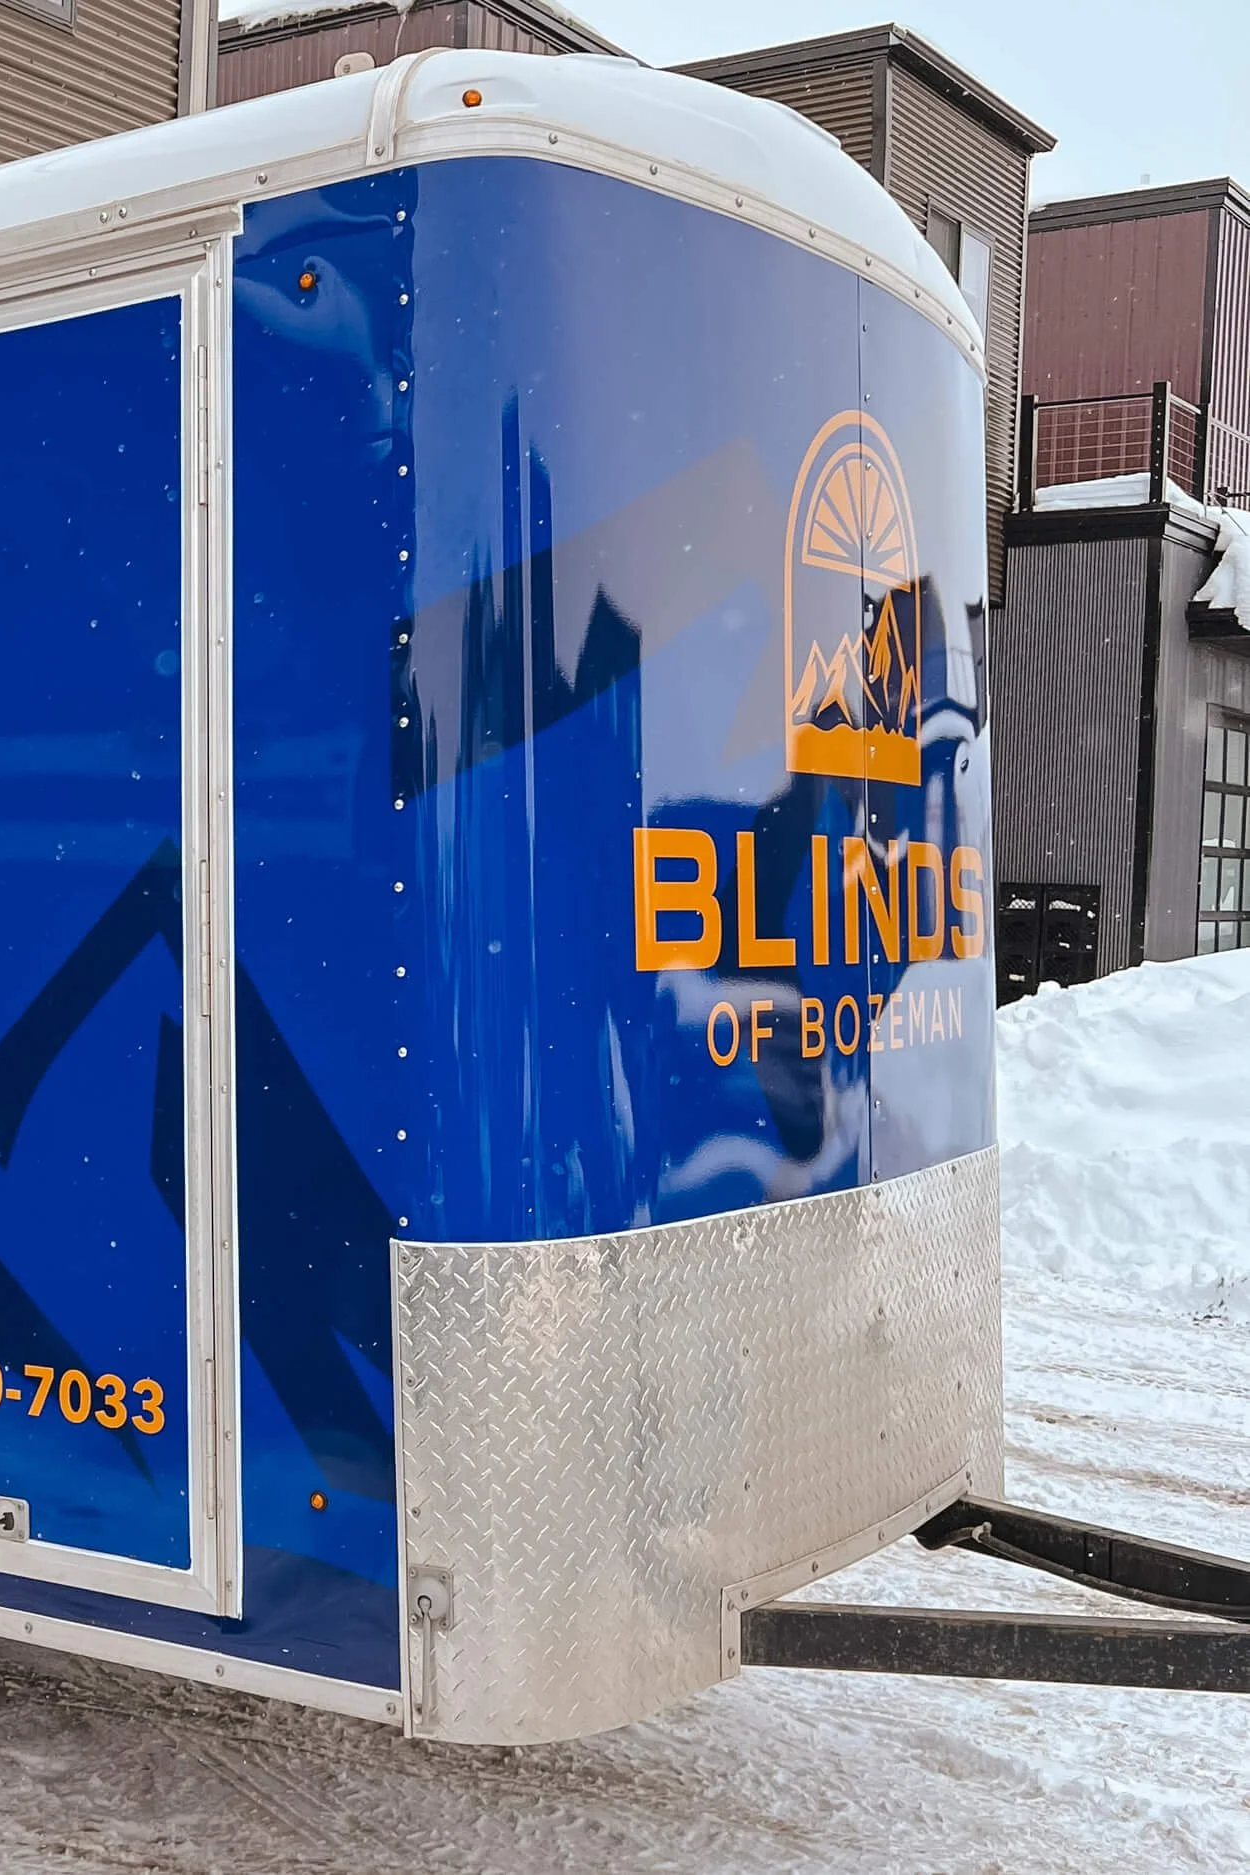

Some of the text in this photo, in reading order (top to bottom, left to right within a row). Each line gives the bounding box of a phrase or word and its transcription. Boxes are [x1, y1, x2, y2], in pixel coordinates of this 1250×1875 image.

[632, 828, 985, 972] BLINDS
[706, 986, 964, 1067] OF BOZEMAN
